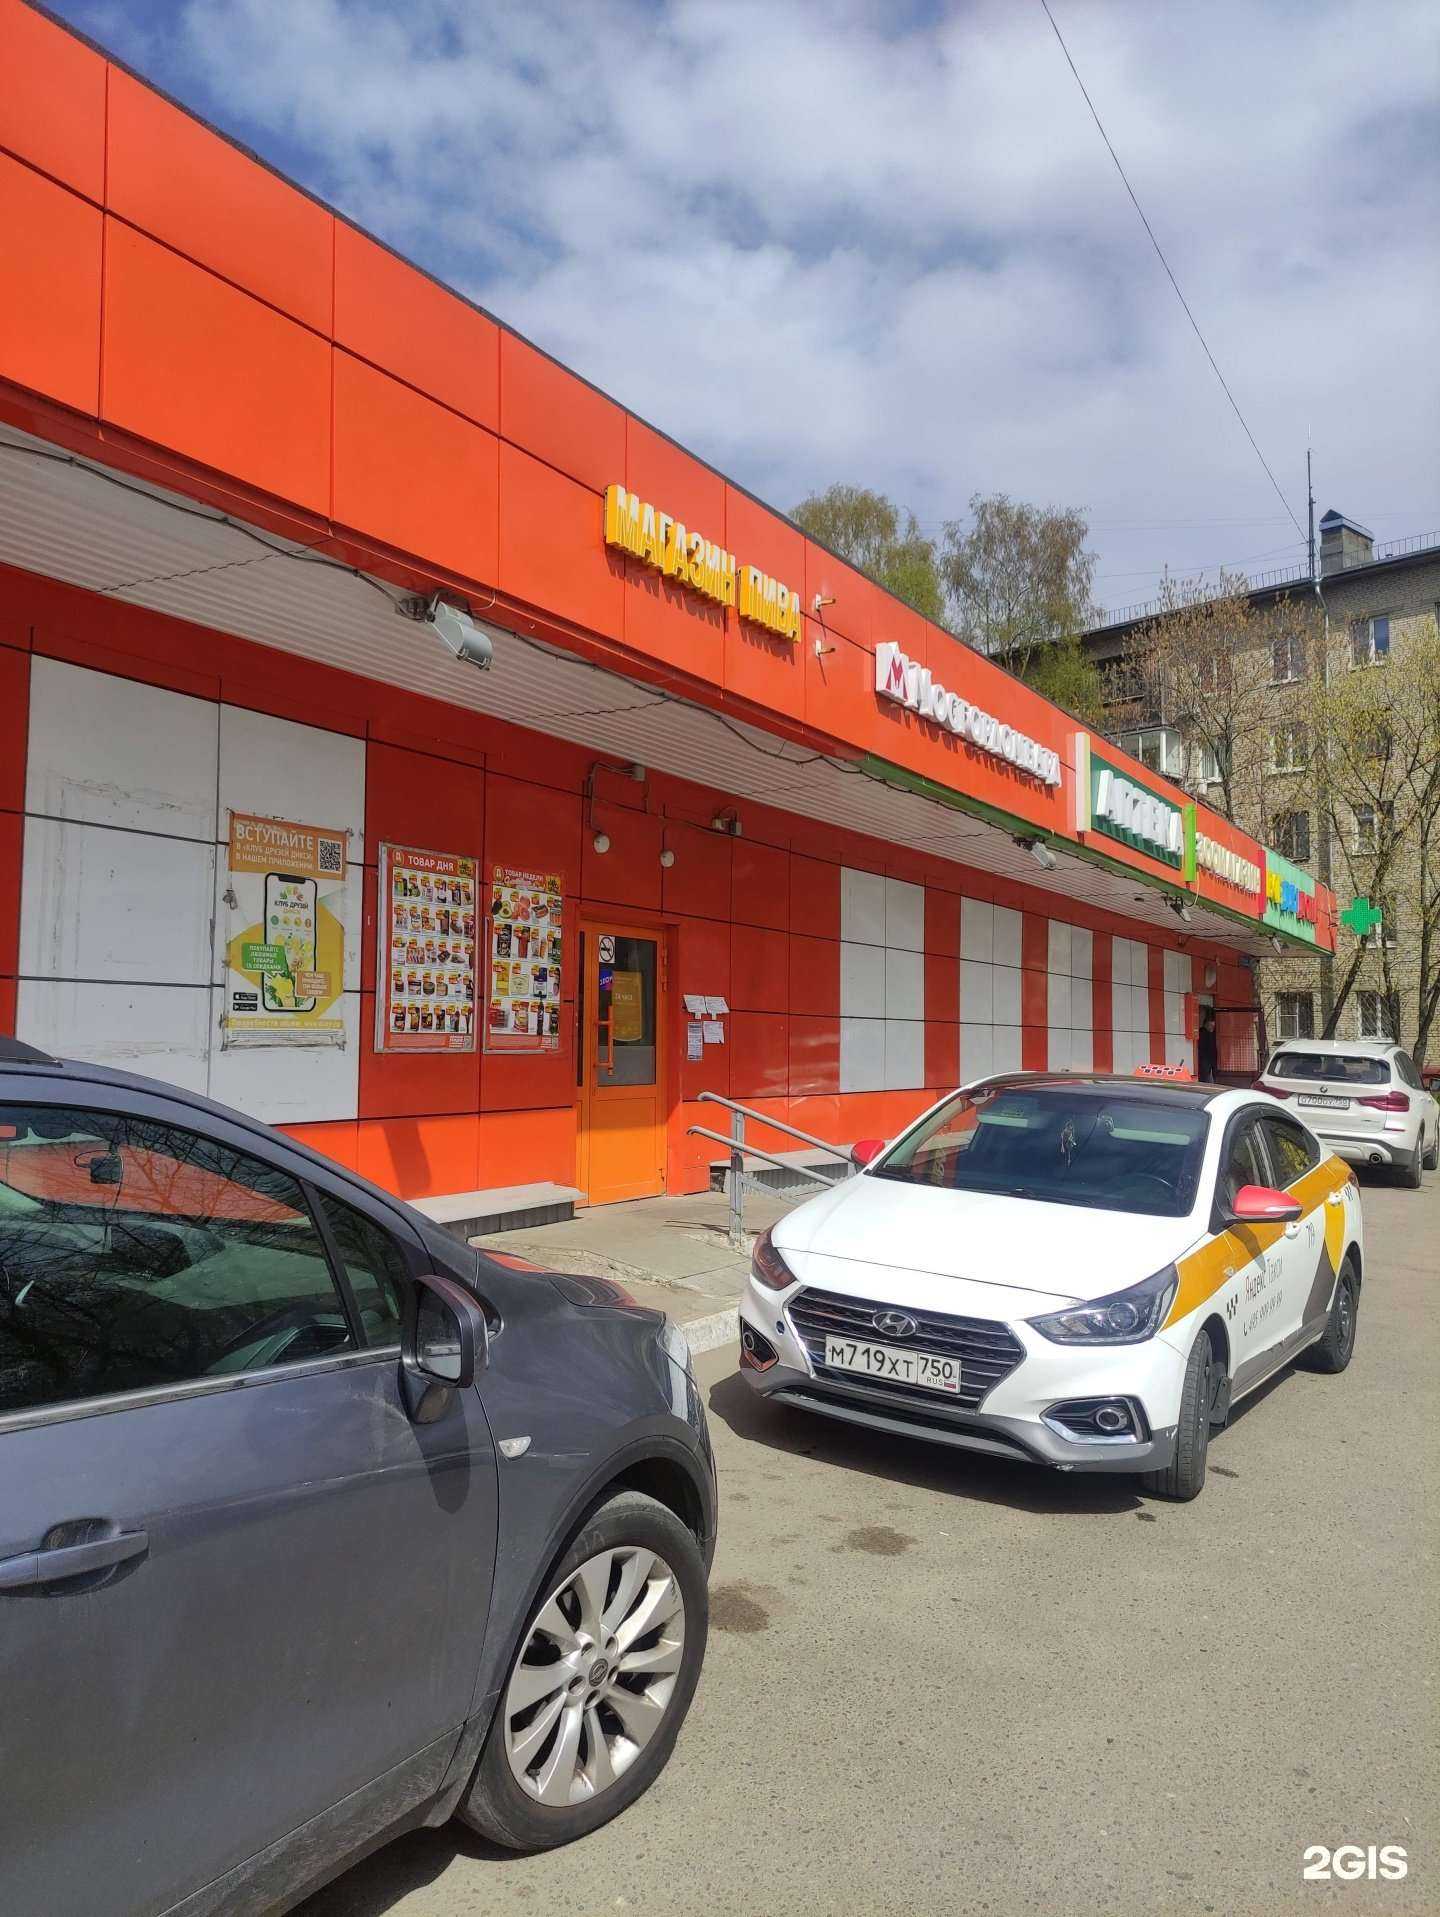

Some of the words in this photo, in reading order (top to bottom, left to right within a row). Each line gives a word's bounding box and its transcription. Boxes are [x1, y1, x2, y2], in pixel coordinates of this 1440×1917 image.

[605, 484, 736, 608] МАГАЗИН
[738, 564, 801, 643] ПИВА
[1096, 769, 1183, 855] АПТЕКА
[235, 823, 314, 850] ВСТУПАЙТЕ
[408, 855, 435, 869] ТОВАР
[437, 860, 454, 872] ДНЯ
[504, 869, 523, 878] ТОВАР
[829, 1343, 914, 1379] М719ХТ
[920, 1356, 953, 1379] 750
[926, 1376, 943, 1386] RUS
